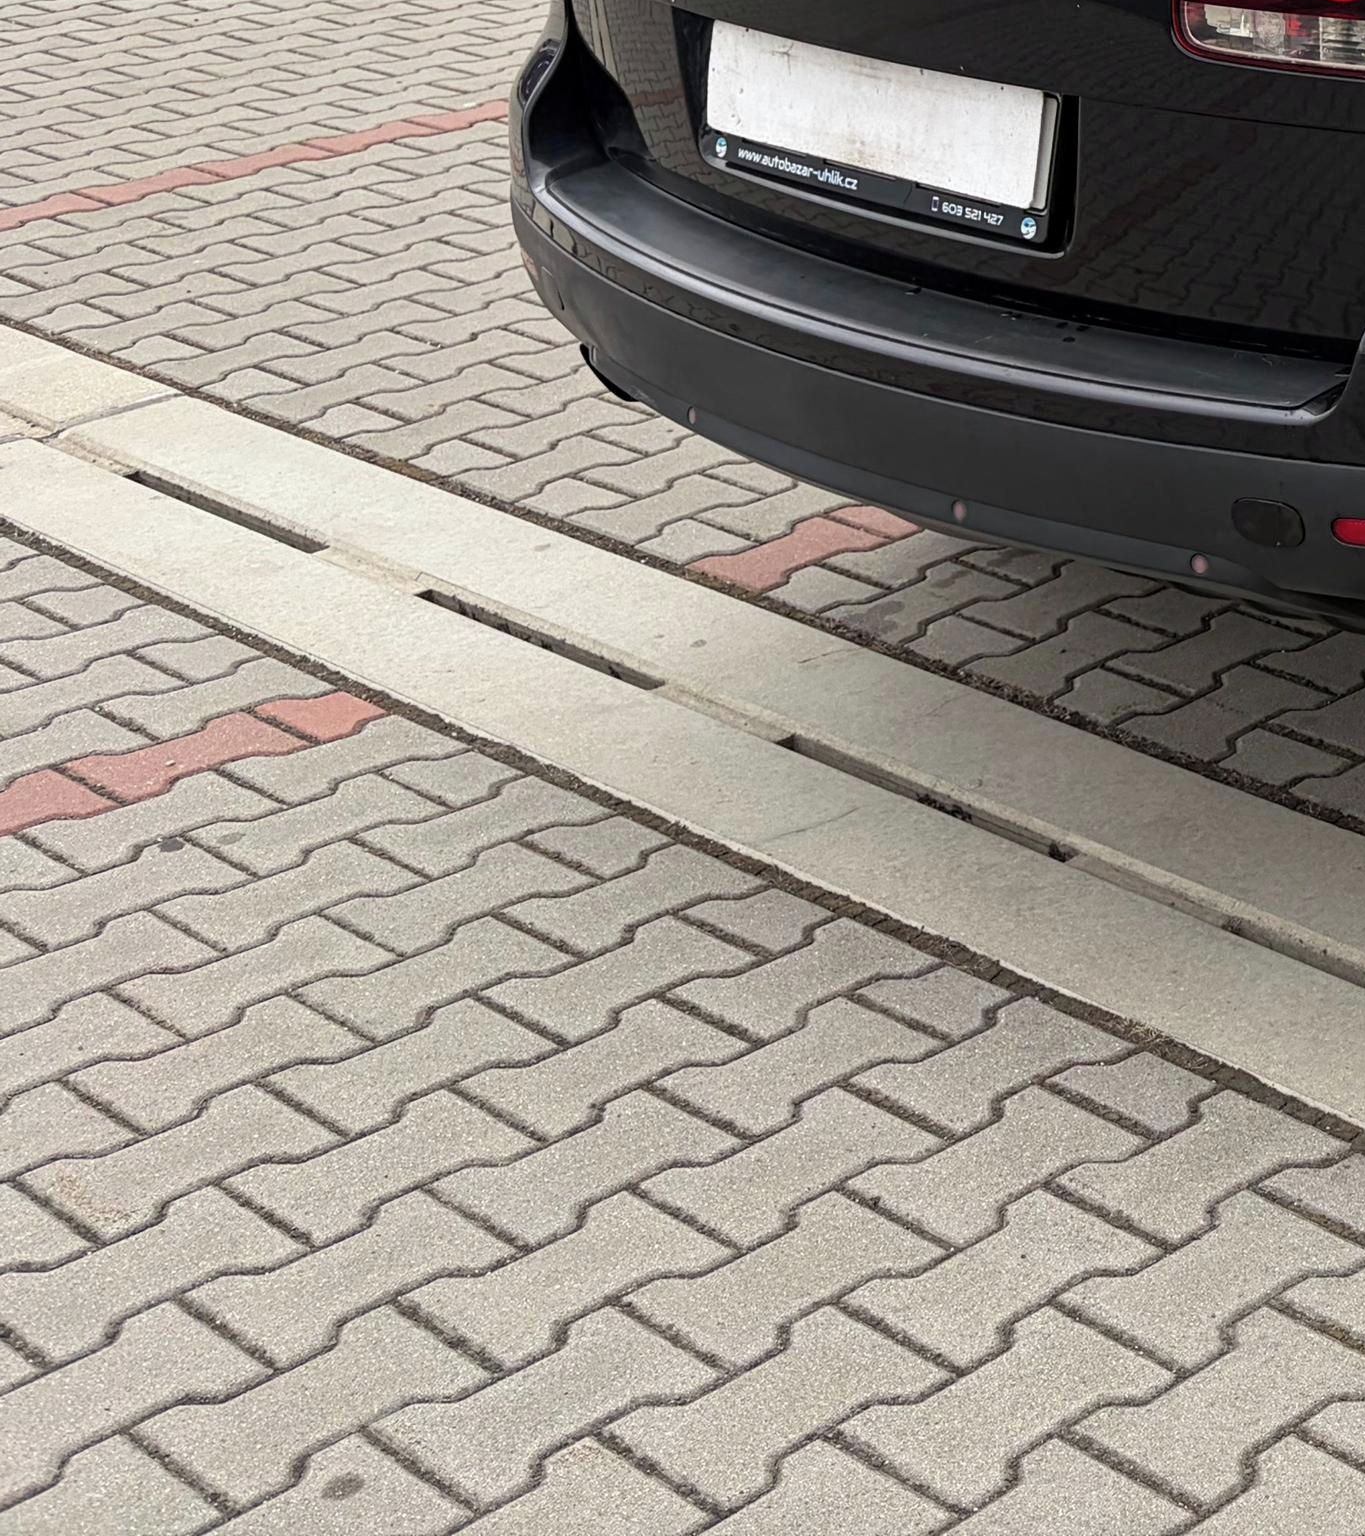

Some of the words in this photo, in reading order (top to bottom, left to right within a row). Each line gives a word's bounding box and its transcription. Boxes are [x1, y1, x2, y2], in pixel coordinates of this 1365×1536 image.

[941, 201, 963, 217] 603
[964, 207, 982, 222] 521
[983, 211, 1004, 226] 427
